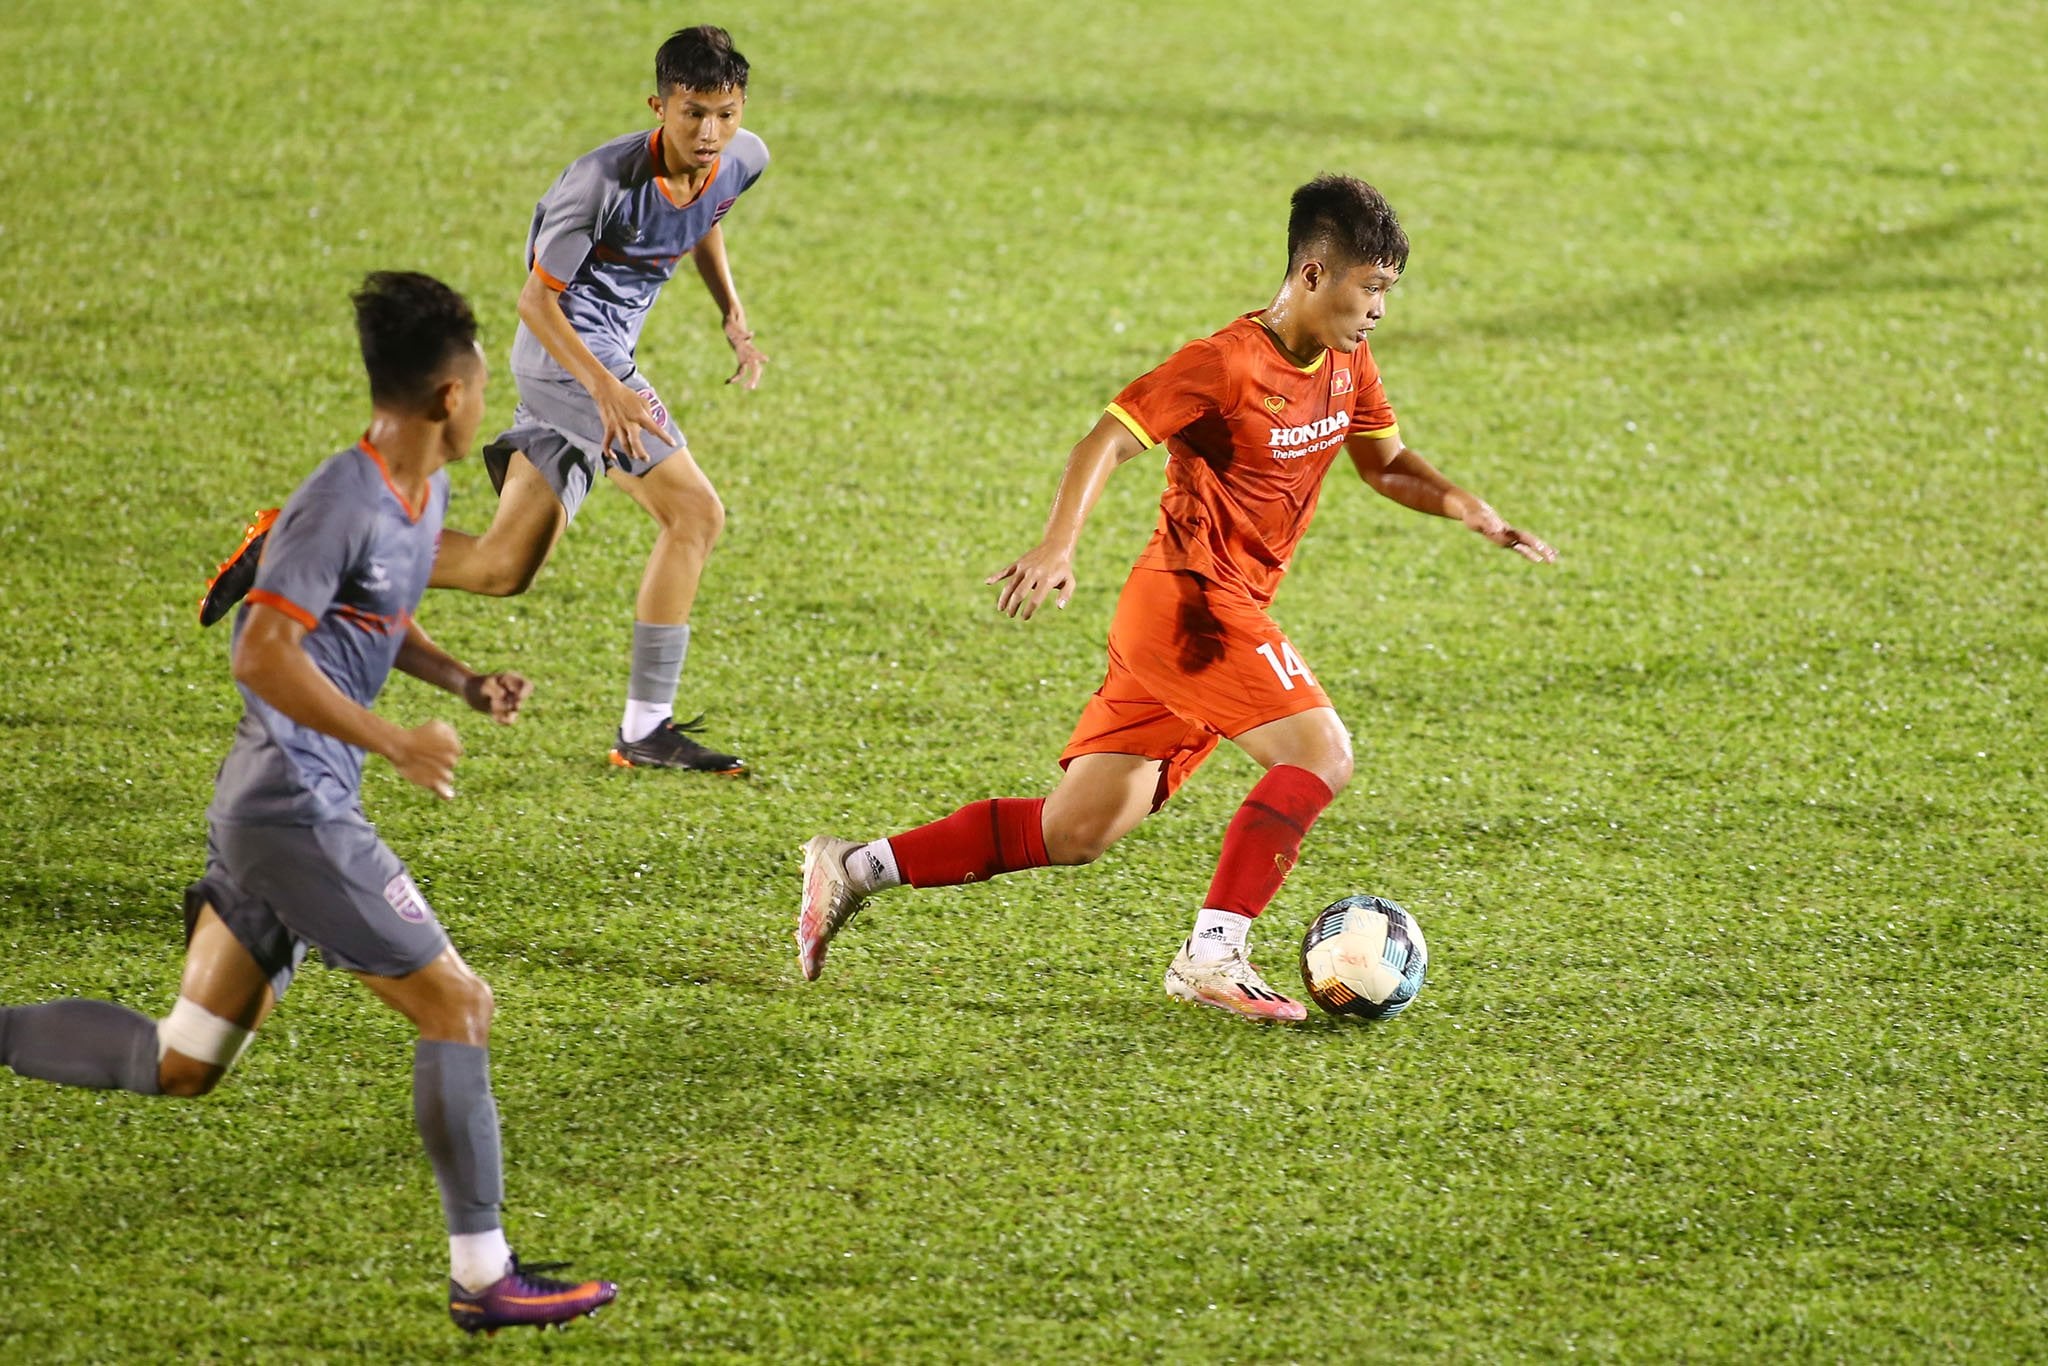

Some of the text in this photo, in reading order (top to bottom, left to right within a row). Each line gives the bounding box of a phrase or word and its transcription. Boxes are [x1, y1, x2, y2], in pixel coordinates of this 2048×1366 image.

[1268, 410, 1350, 446] HONDA
[1272, 449, 1288, 459] The
[1288, 447, 1308, 459] Powe
[1319, 434, 1345, 450] Dream
[1255, 641, 1316, 691] 14
